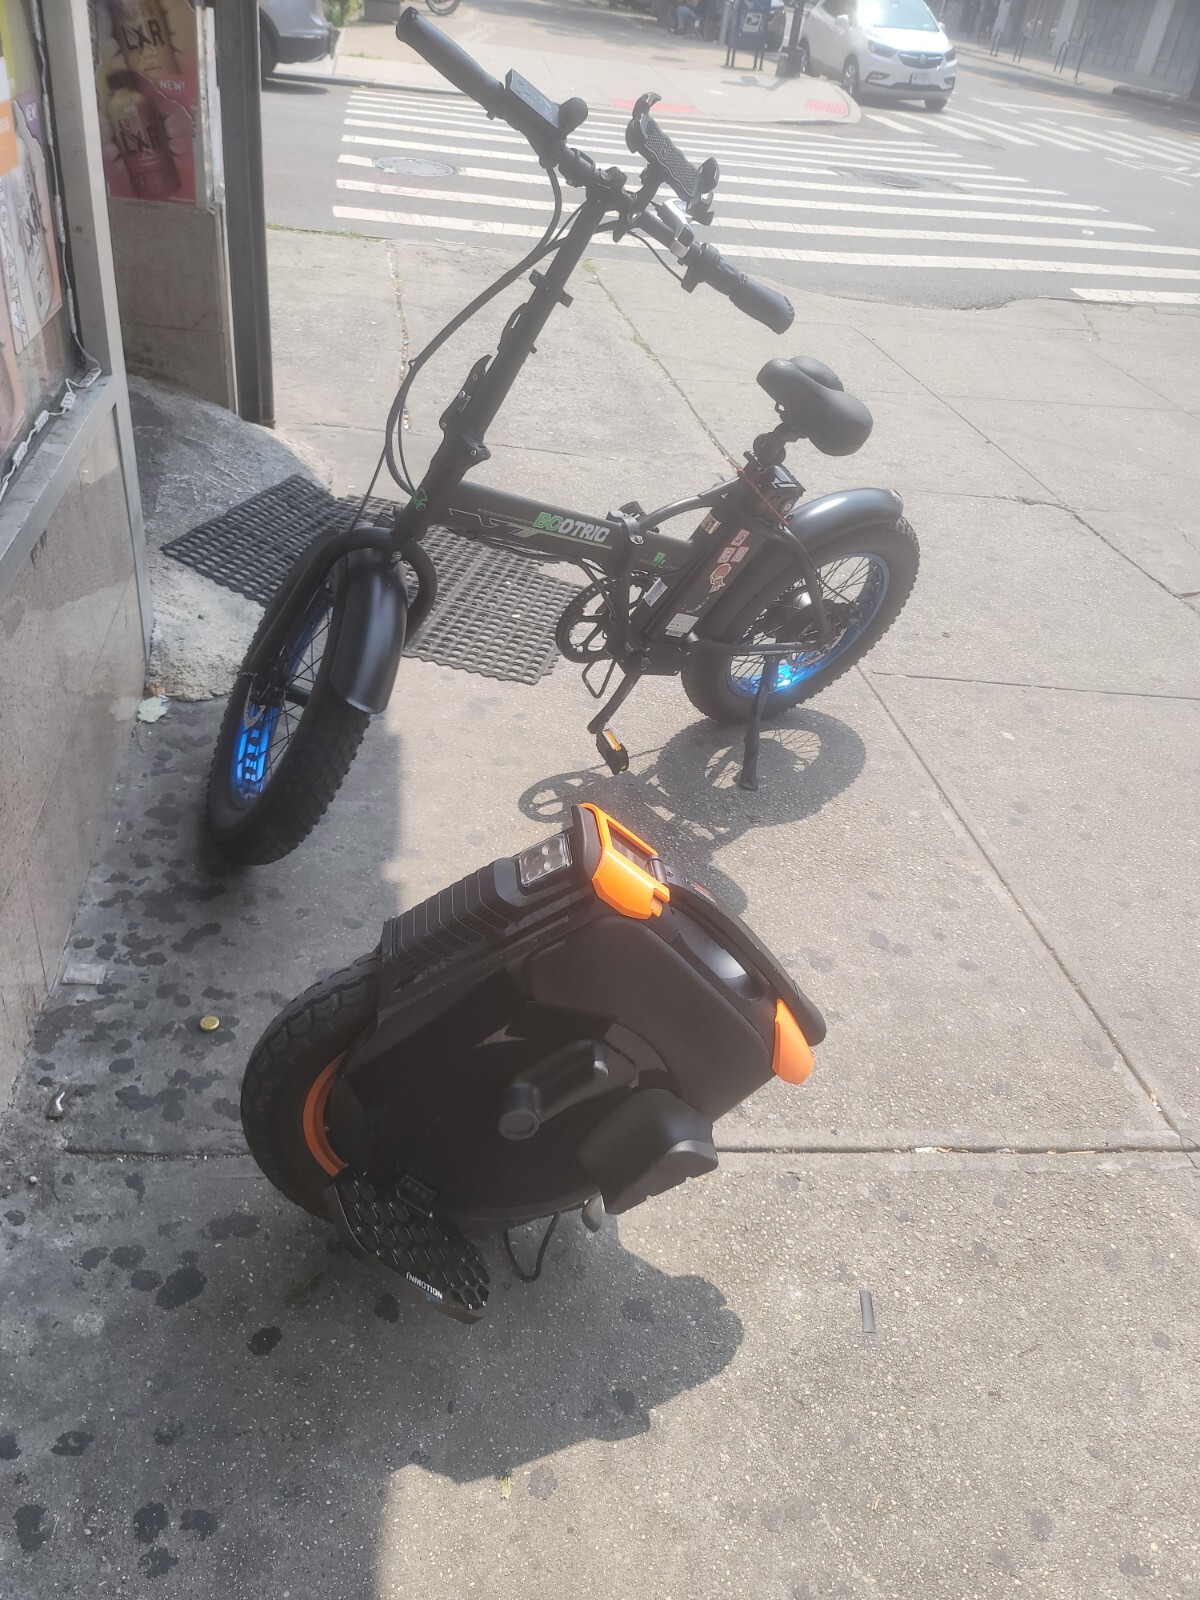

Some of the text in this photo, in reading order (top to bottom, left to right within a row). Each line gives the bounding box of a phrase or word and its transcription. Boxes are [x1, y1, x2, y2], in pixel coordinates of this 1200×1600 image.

[120, 18, 166, 54] LXR
[160, 79, 185, 92] NEW!
[406, 1271, 443, 1300] INMOTION
